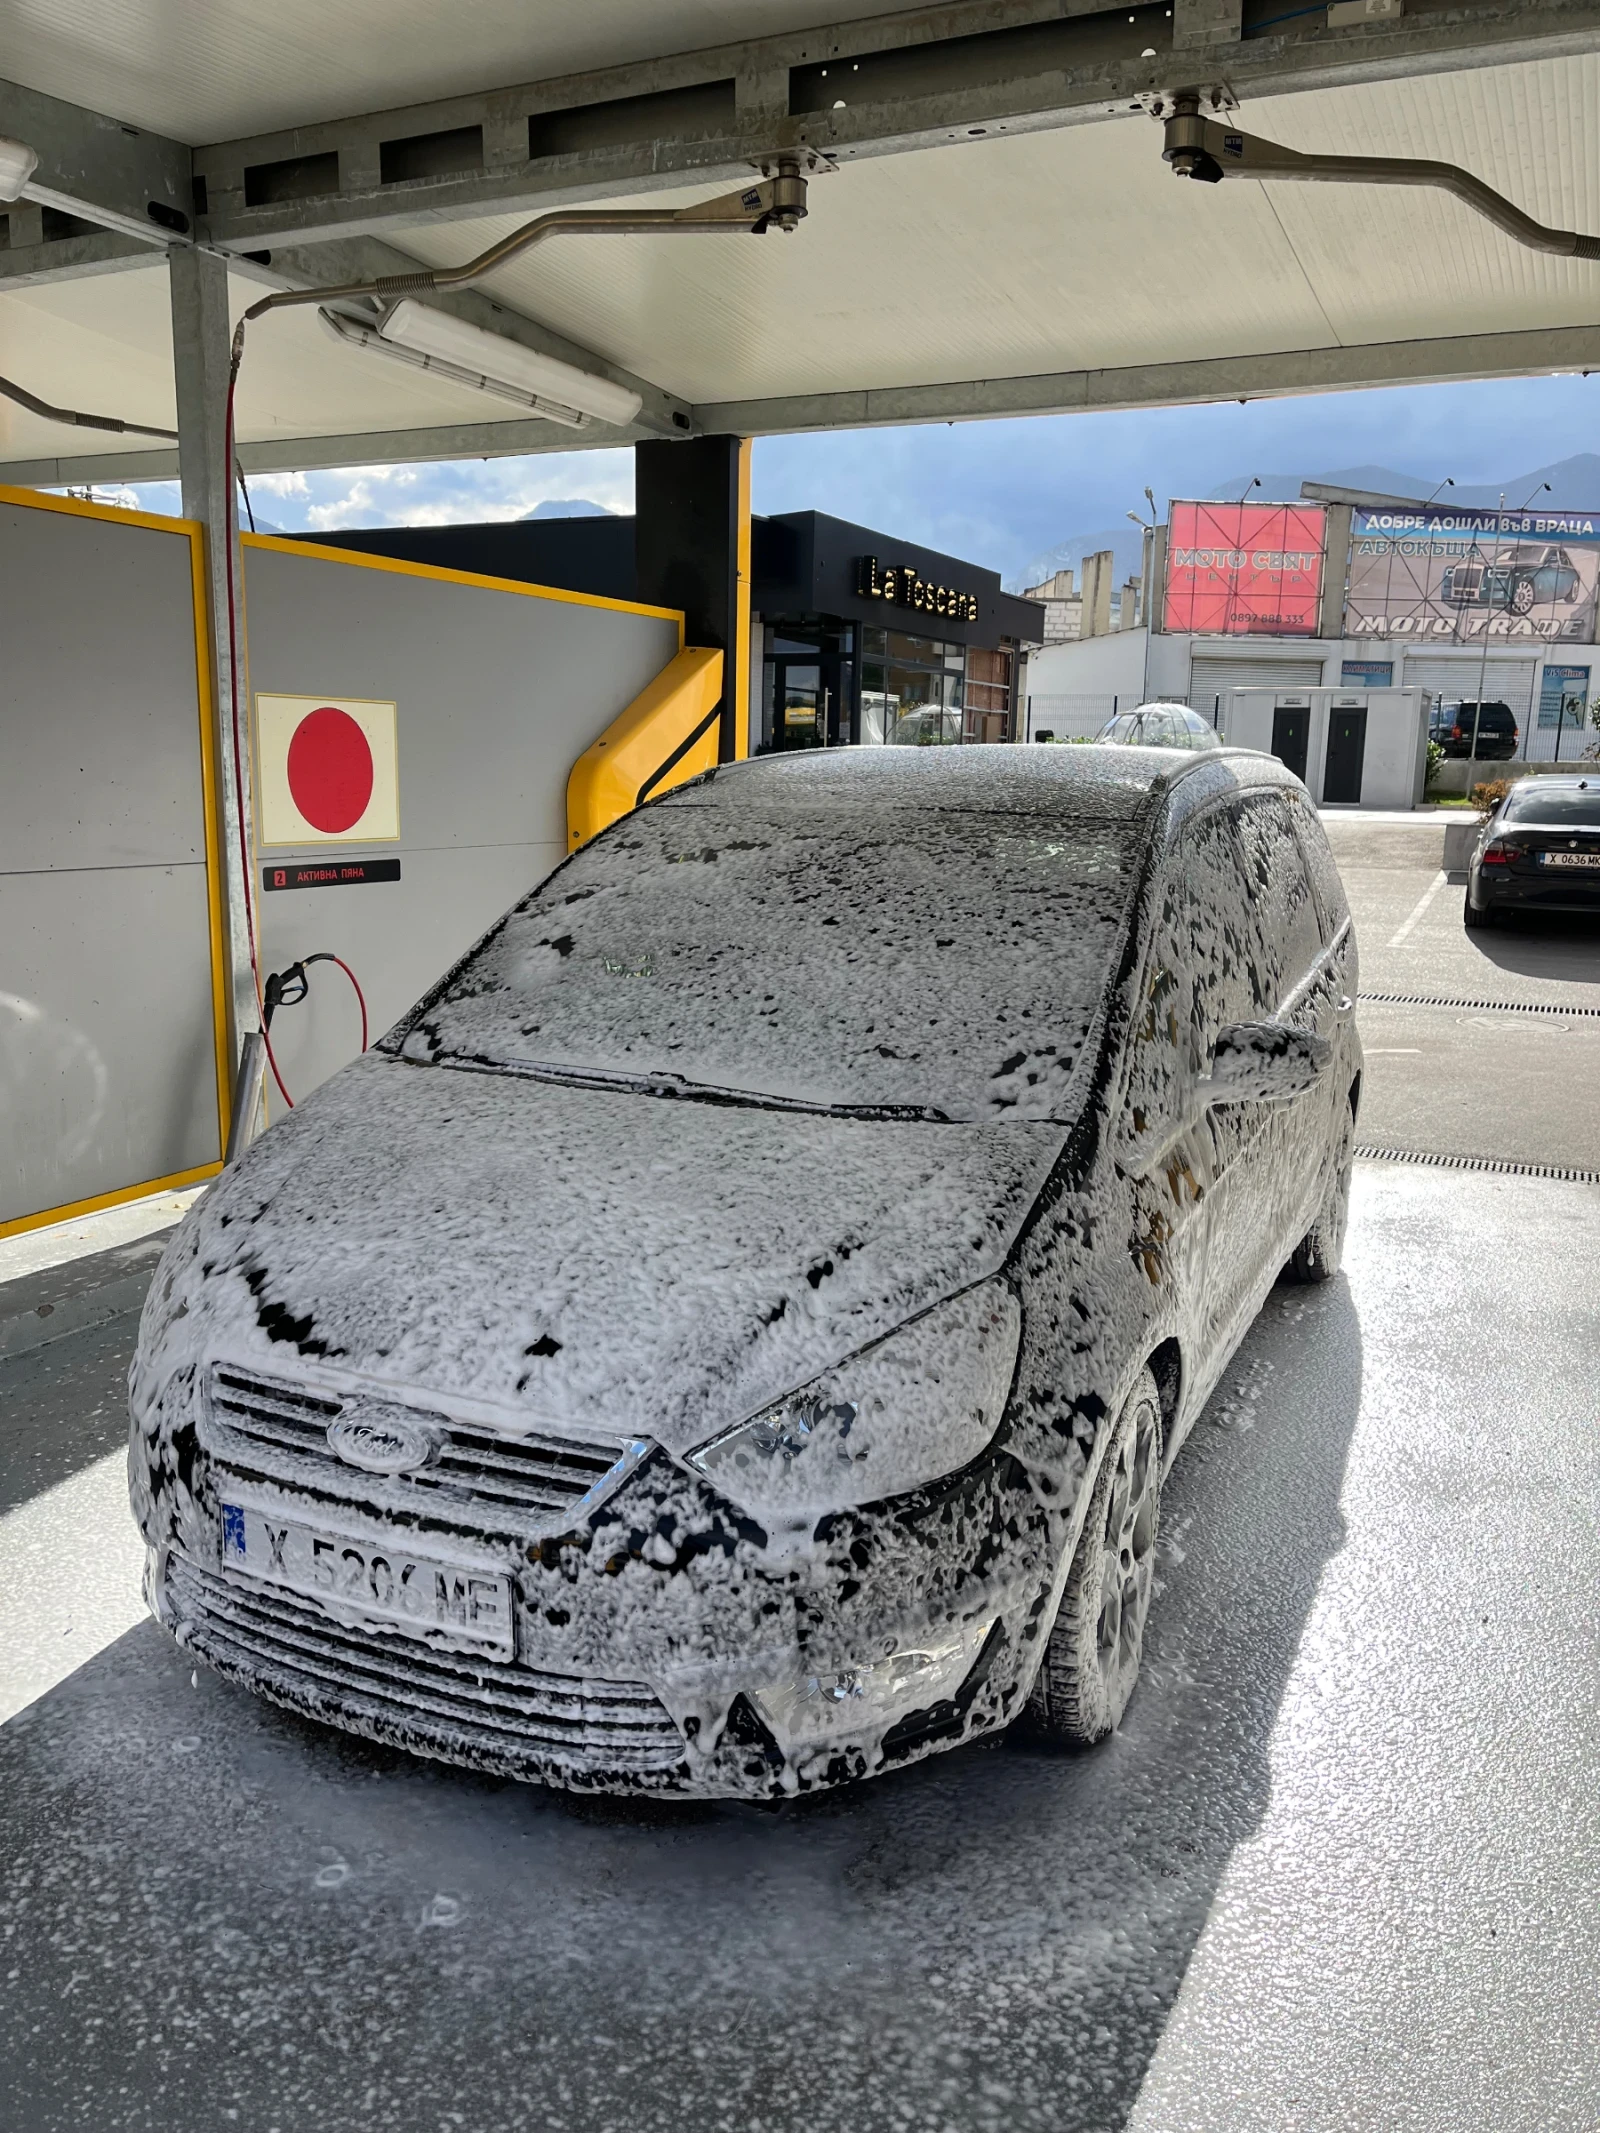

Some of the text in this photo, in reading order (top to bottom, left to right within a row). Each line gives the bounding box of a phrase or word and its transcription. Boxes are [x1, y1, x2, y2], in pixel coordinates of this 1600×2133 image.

[1365, 514, 1426, 531] ДОБРЕ
[1428, 516, 1496, 533] ДОШЛИ
[1535, 519, 1594, 536] ВРАЦА
[1174, 547, 1317, 571] МОТО СВЯТ
[1358, 538, 1481, 560] АВТОКЪЩА
[864, 555, 978, 621] La Toscana
[1230, 613, 1304, 624] 0897 888 333
[1467, 617, 1585, 637] TRADE
[1560, 667, 1585, 678] Clima
[1550, 854, 1600, 865] X 0636 MK
[297, 869, 338, 882] АКТИВНА
[341, 867, 365, 879] ПЯНА
[264, 1522, 290, 1579] X
[313, 1538, 424, 1614] 5206
